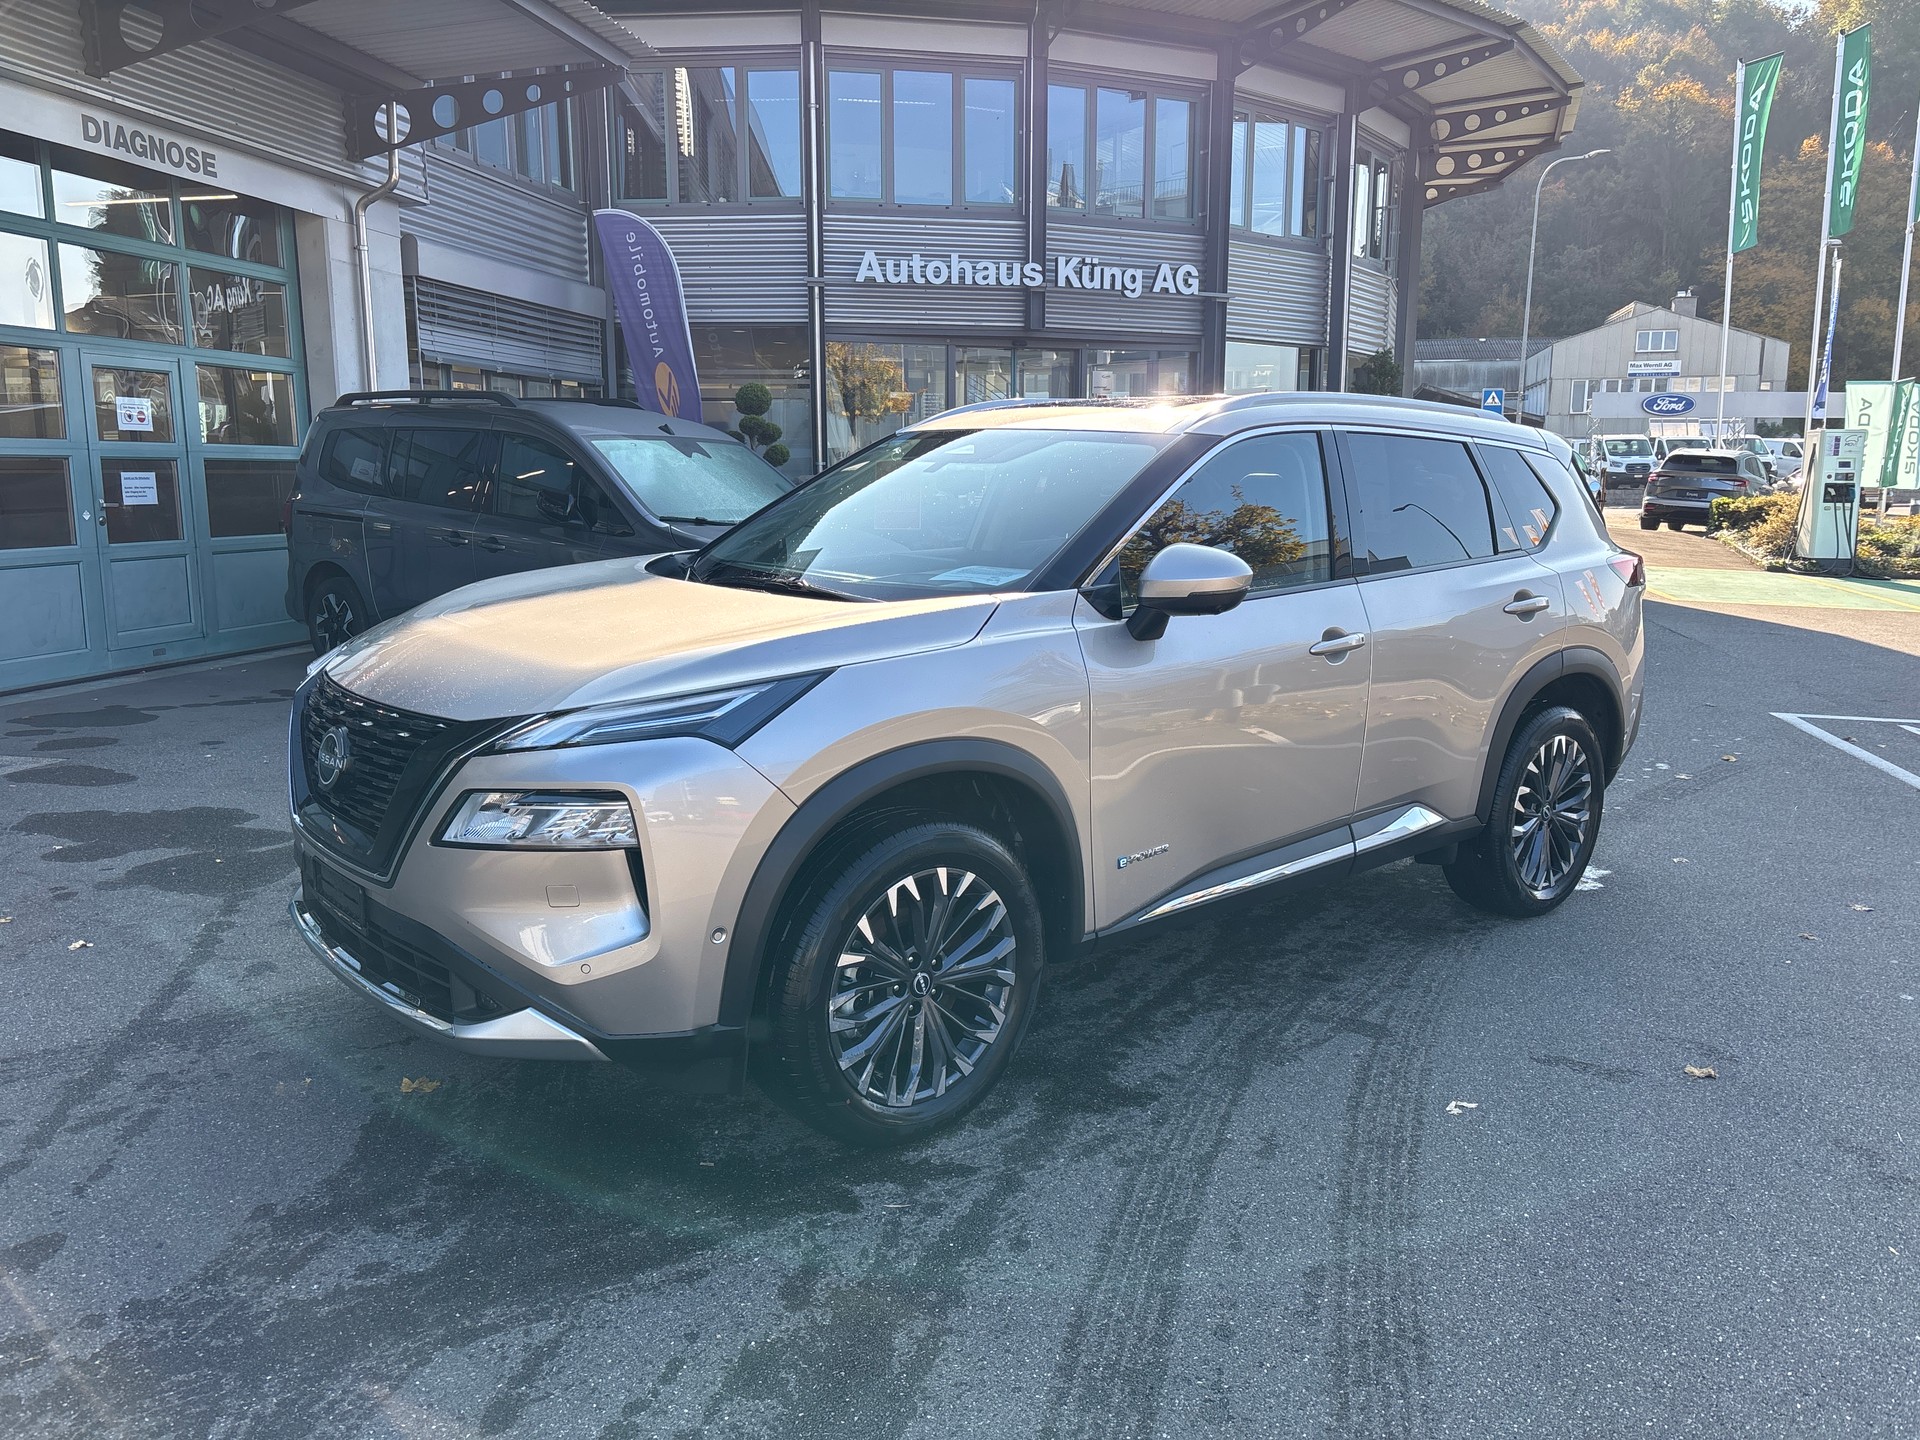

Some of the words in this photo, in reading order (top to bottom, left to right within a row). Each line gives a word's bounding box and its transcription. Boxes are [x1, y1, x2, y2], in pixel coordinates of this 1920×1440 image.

[81, 114, 218, 178] DIAGNOSE
[855, 250, 1044, 287] Autohaus
[1056, 256, 1143, 298] Küng
[1152, 263, 1199, 295] AG
[1653, 397, 1686, 411] Ford
[320, 752, 344, 769] SSAN
